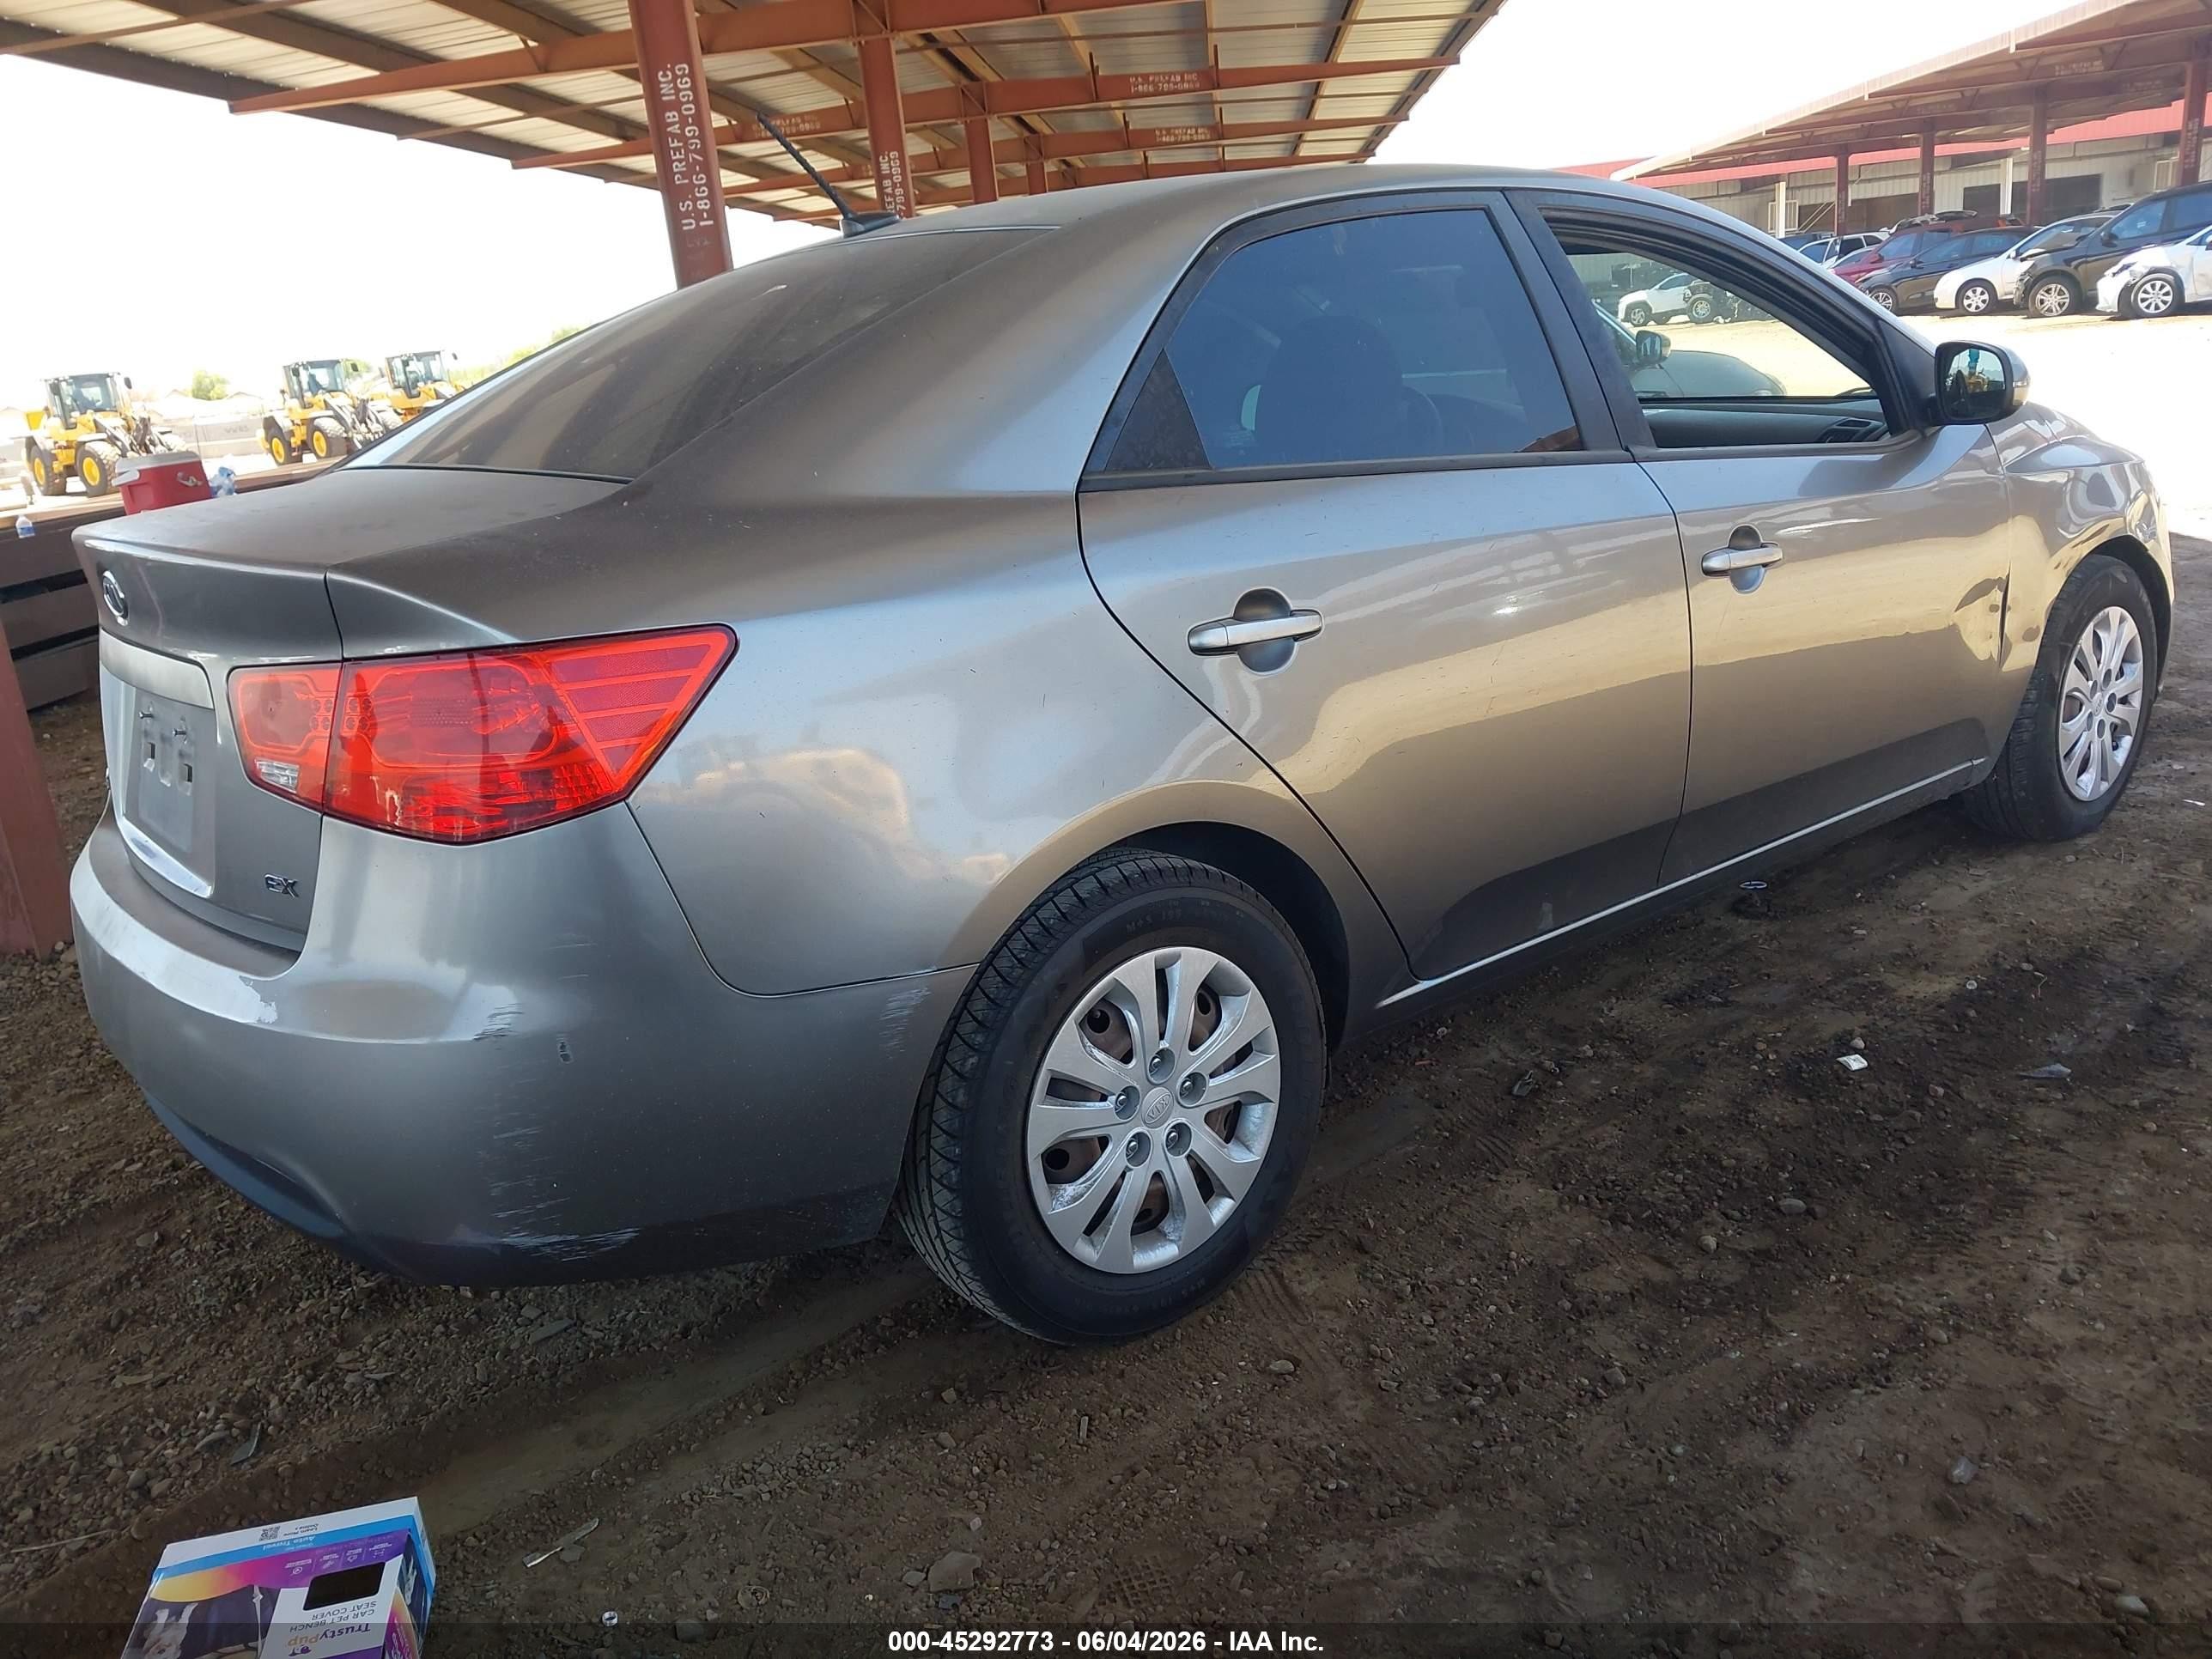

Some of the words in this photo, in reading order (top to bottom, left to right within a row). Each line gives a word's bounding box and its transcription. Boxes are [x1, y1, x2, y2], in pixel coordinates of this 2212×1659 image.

[658, 64, 676, 100] INC.
[665, 111, 690, 185] PREFAB
[675, 63, 714, 228] 1-866-799-0969
[679, 194, 696, 230] U.S.
[264, 873, 300, 899] EX
[1146, 1095, 1170, 1121] KIA
[312, 1607, 347, 1620] COVER
[349, 1601, 378, 1612] SEAT
[352, 1608, 374, 1620] CAR
[289, 1620, 326, 1632] BENCH
[329, 1614, 349, 1625] PET
[288, 1623, 371, 1646] TrustyPup
